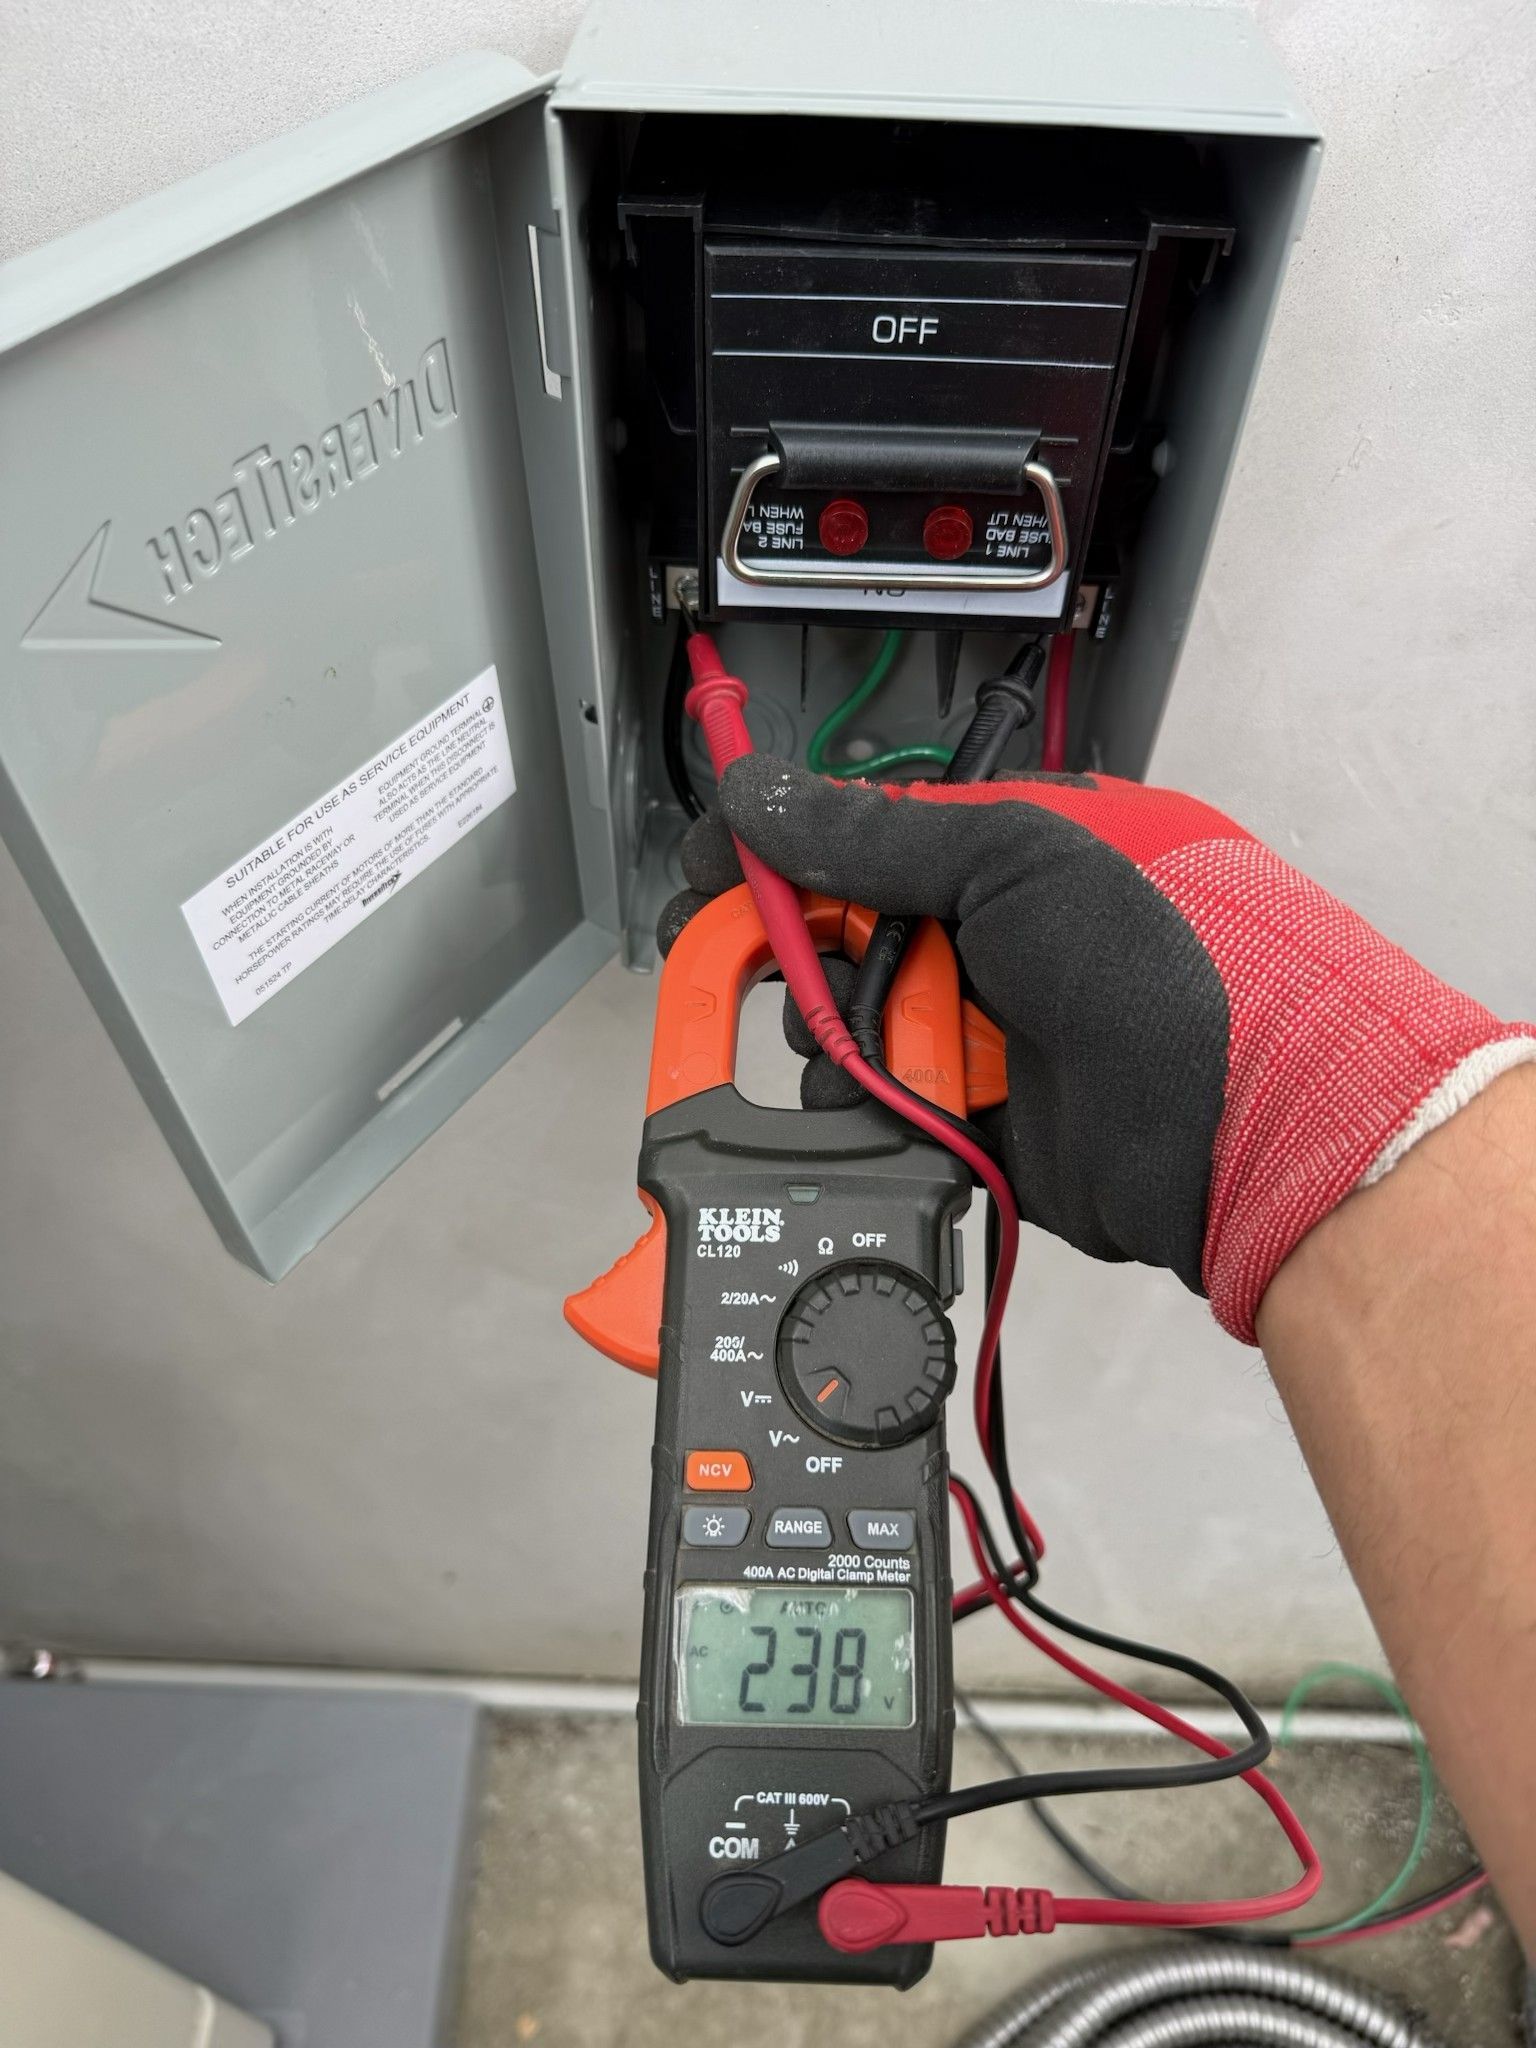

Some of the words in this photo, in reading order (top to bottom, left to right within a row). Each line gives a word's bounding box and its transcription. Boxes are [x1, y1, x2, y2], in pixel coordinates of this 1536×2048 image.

[873, 316, 940, 345] OFF
[760, 505, 804, 519] WHEN
[987, 513, 1009, 526] LIT
[742, 521, 762, 534] BA
[766, 522, 804, 535] FUSE
[985, 528, 1017, 542] BAD
[758, 535, 768, 548] 2
[772, 536, 804, 550] LINE
[1019, 530, 1052, 544] USE
[985, 543, 992, 556] 1
[996, 545, 1030, 558] LINE
[648, 565, 663, 618] LINE
[1095, 585, 1116, 639] LINE
[225, 836, 286, 890] SUITABLE
[287, 815, 313, 842] FOR
[315, 794, 340, 821] USE
[340, 780, 357, 801] AS
[358, 741, 407, 787] SERVICE
[409, 692, 470, 748] EQUIPMENT
[221, 892, 247, 918] WHEN
[248, 848, 303, 897] INSTALLATION
[304, 841, 312, 853] IS
[312, 824, 333, 846] WITH
[229, 882, 277, 925] EQUIPMENT
[277, 846, 322, 887] GROUNDED
[321, 838, 333, 852] BY
[212, 904, 266, 952] CONNECTION
[266, 894, 278, 908] TO
[279, 873, 304, 898] METAL
[305, 843, 341, 877] RACEWAY
[342, 832, 355, 847] OR
[238, 908, 277, 944] METALLIC
[277, 887, 303, 913] CABLE
[303, 858, 339, 891] SHEATHS
[902, 1067, 950, 1085] 400A
[698, 1224, 781, 1243] TOOLS
[852, 1232, 887, 1247] OFF
[697, 1244, 741, 1258] CL120
[698, 1463, 733, 1478] NCV
[805, 1456, 843, 1473] OFF
[774, 1520, 823, 1535] RANGE
[867, 1522, 899, 1536] MAX
[828, 1554, 861, 1568] 2000
[864, 1556, 911, 1570] Counts
[743, 1566, 774, 1578] 400A
[777, 1567, 796, 1578] AC
[798, 1568, 834, 1582] Digital
[837, 1569, 874, 1583] Clamp
[877, 1570, 911, 1582] Meter
[689, 1645, 709, 1658] AC
[739, 1626, 866, 1714] 238
[883, 1696, 895, 1711] V
[756, 1791, 783, 1804] CAT
[784, 1792, 797, 1805] III
[798, 1793, 830, 1806] 600V
[708, 1836, 759, 1859] COM
